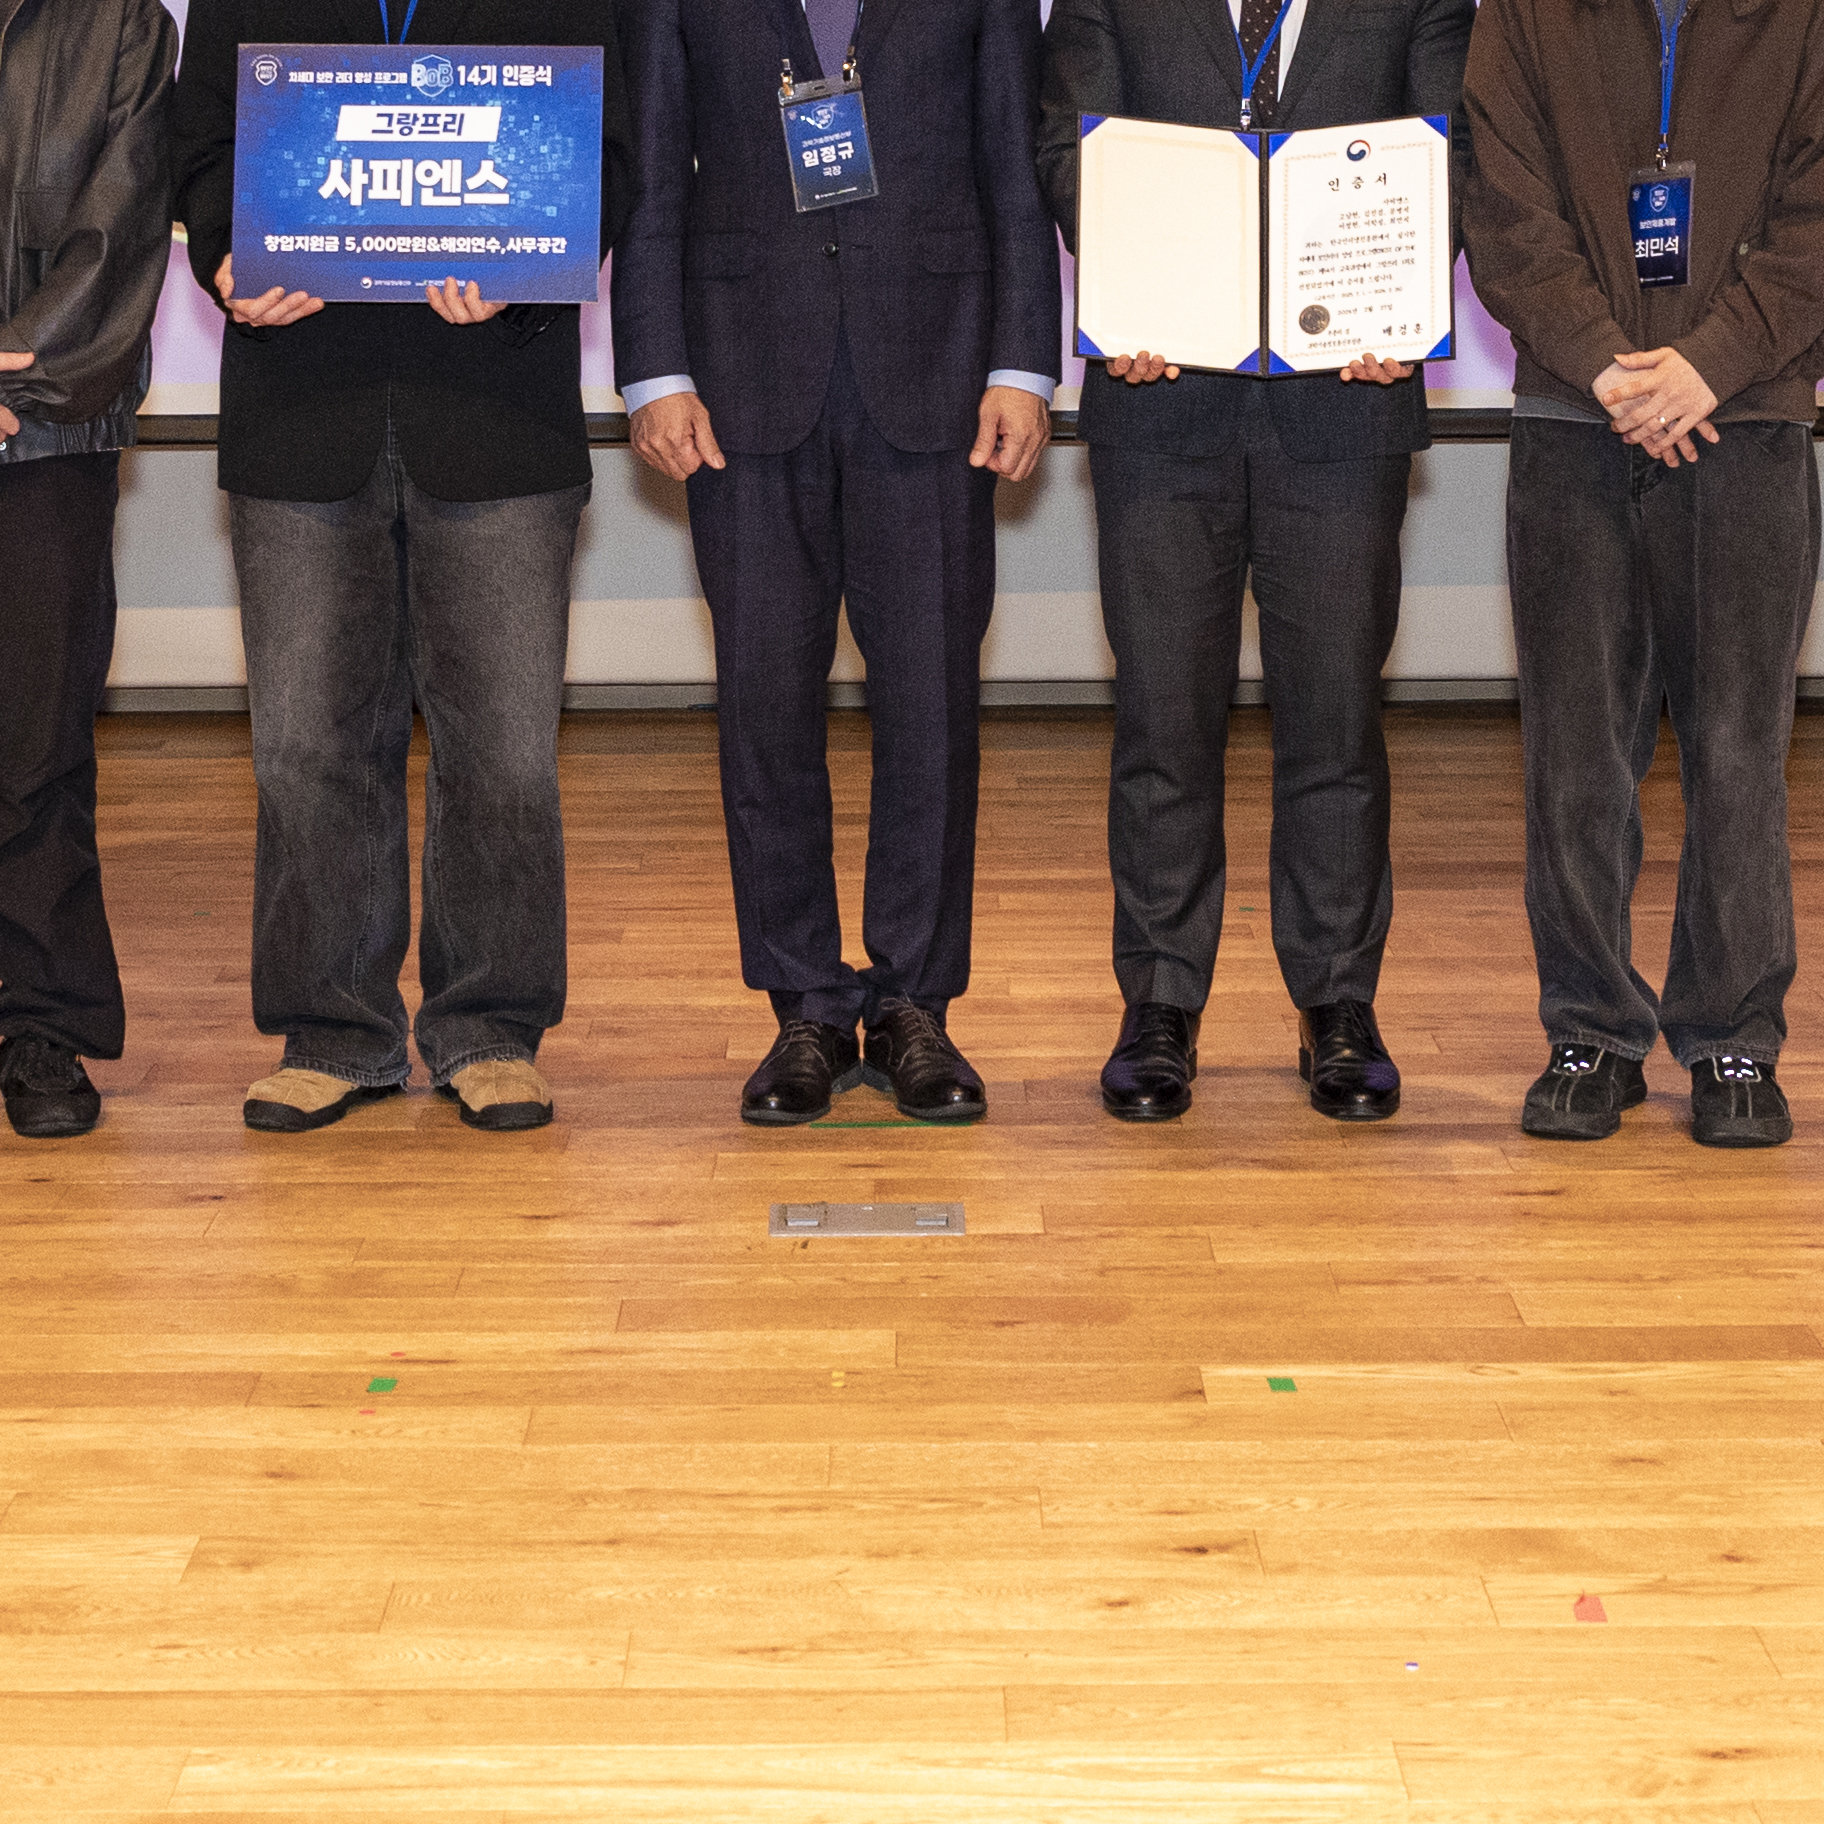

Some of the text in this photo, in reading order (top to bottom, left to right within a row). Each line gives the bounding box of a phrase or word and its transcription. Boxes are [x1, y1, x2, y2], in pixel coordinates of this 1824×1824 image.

[457, 64, 497, 86] 14기
[502, 64, 552, 87] 인증식
[371, 112, 465, 137] 그랑프리
[801, 141, 855, 168] 임정규
[318, 158, 510, 207] 사피엔스
[822, 165, 842, 177] 국장
[264, 234, 340, 253] 창업지원금
[1635, 235, 1679, 258] 최민석
